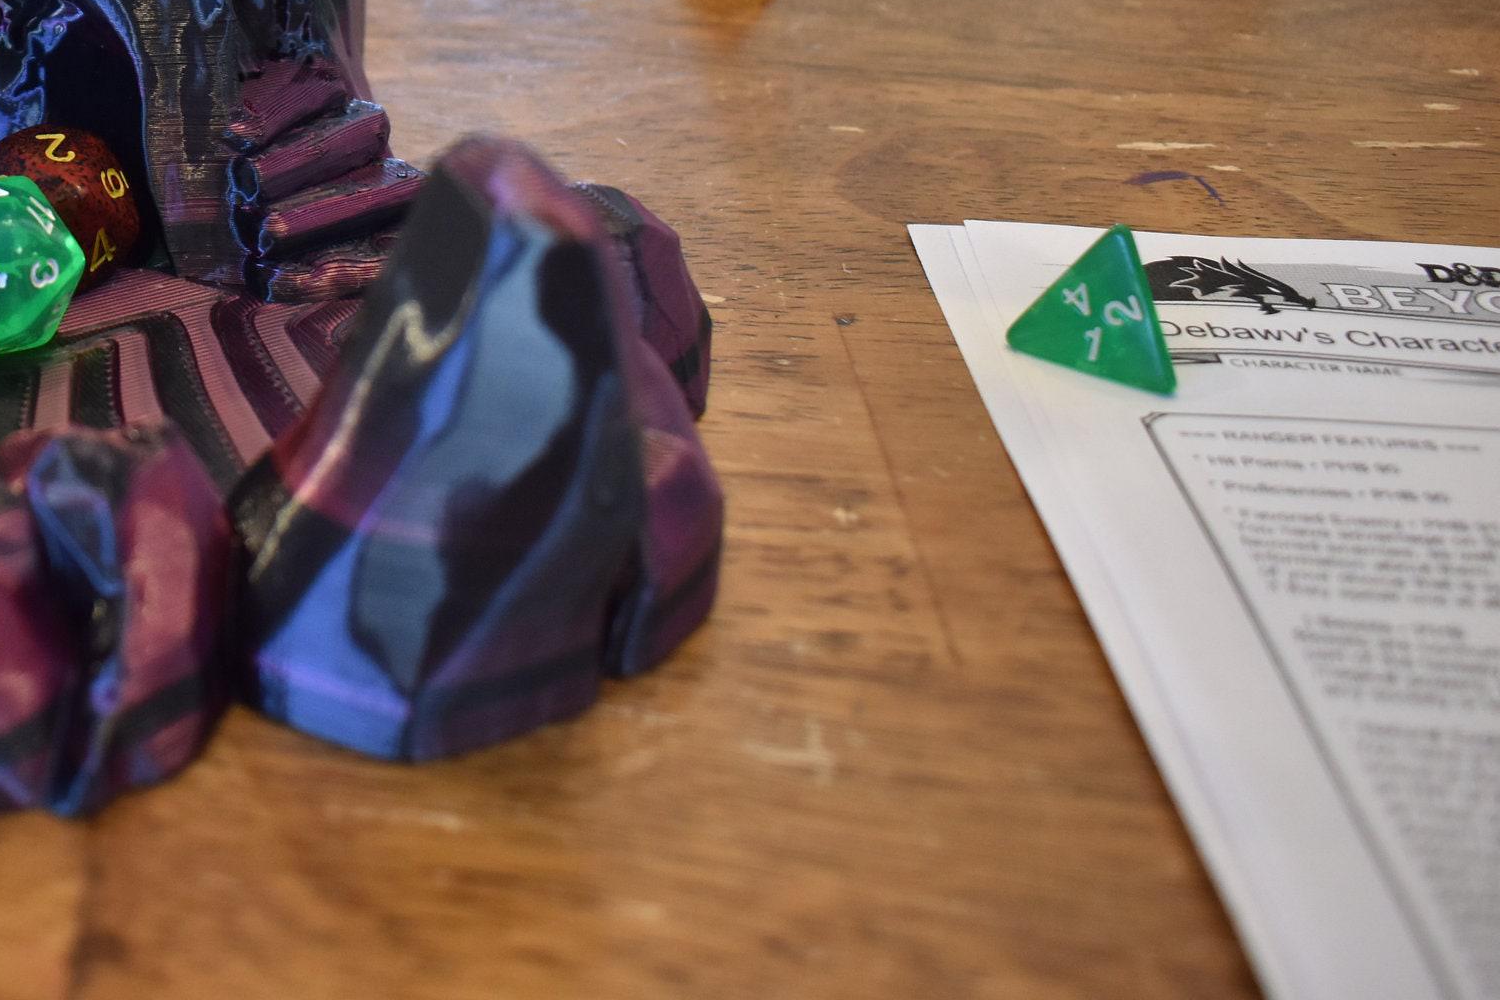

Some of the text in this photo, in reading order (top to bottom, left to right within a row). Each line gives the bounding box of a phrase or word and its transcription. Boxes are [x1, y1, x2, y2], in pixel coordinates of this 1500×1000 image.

[35, 133, 76, 162] 2
[90, 227, 116, 272] 4
[30, 258, 60, 289] 3
[1062, 282, 1092, 317] 4
[1103, 294, 1144, 326] 2
[1084, 326, 1103, 362] 1
